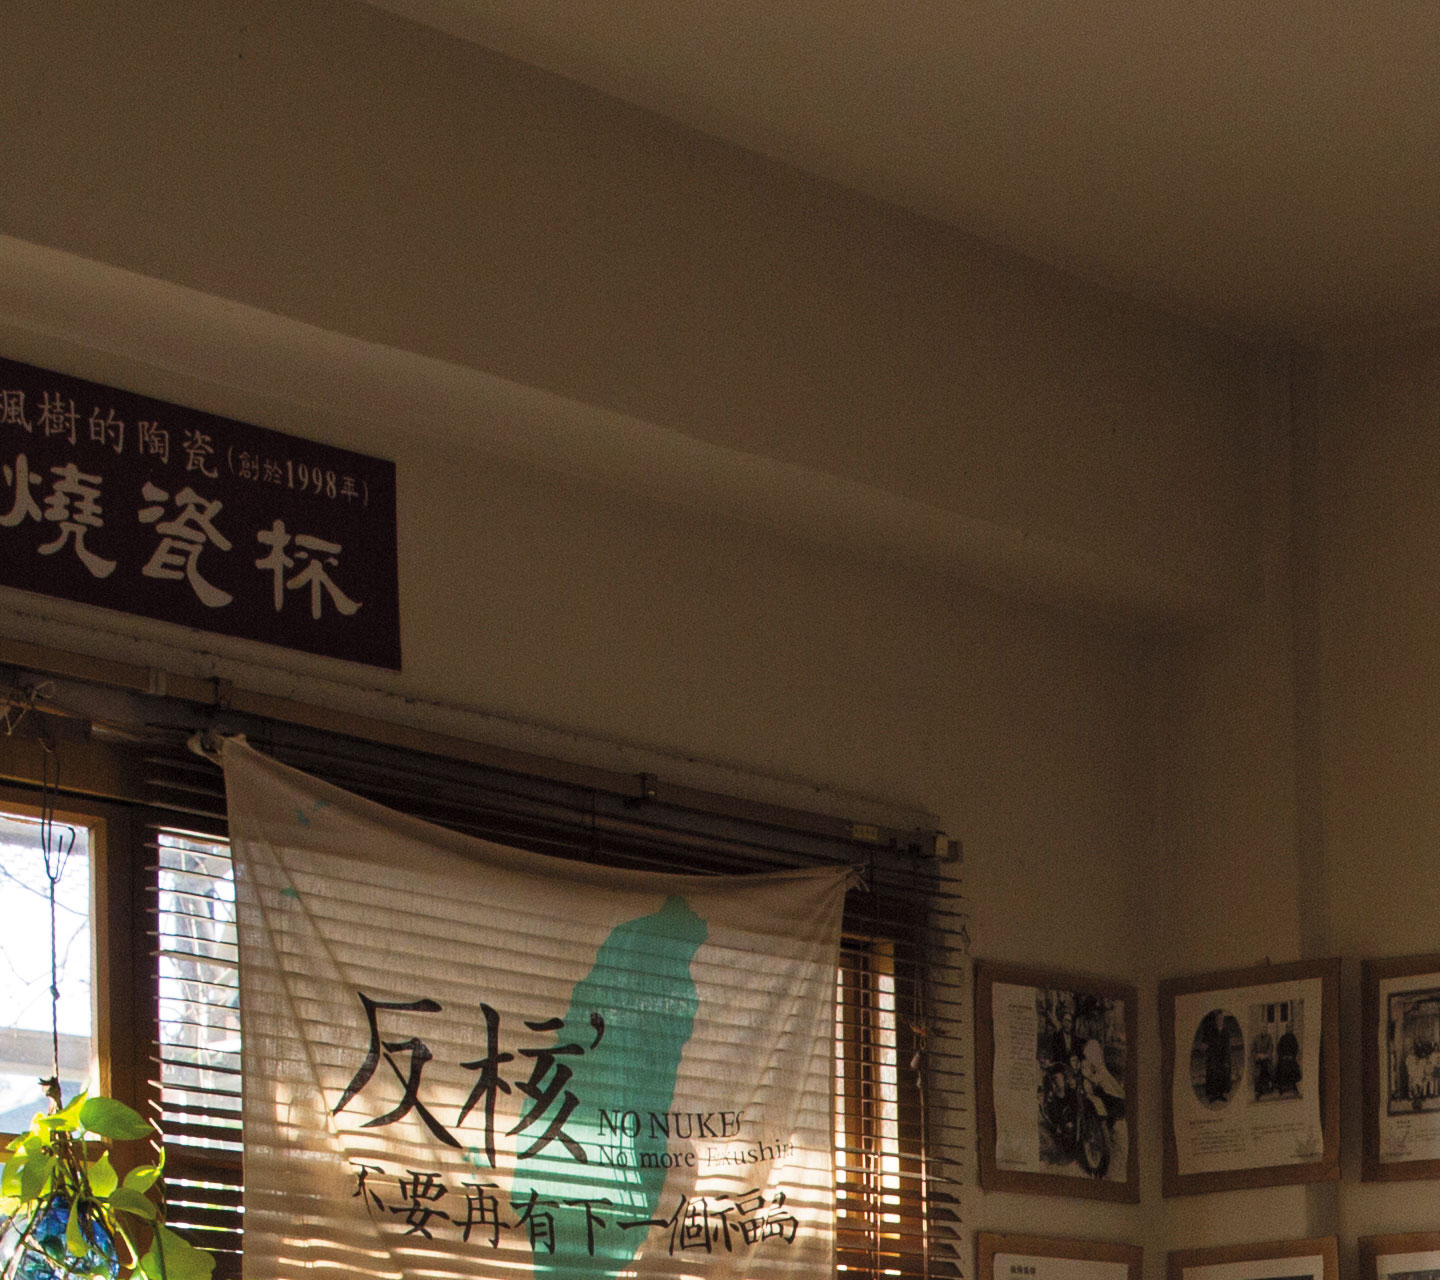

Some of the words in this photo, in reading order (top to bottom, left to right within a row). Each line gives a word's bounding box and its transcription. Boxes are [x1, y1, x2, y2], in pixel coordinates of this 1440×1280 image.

[598, 1108, 641, 1138] NO
[598, 1143, 628, 1168] No
[639, 1148, 696, 1169] more
